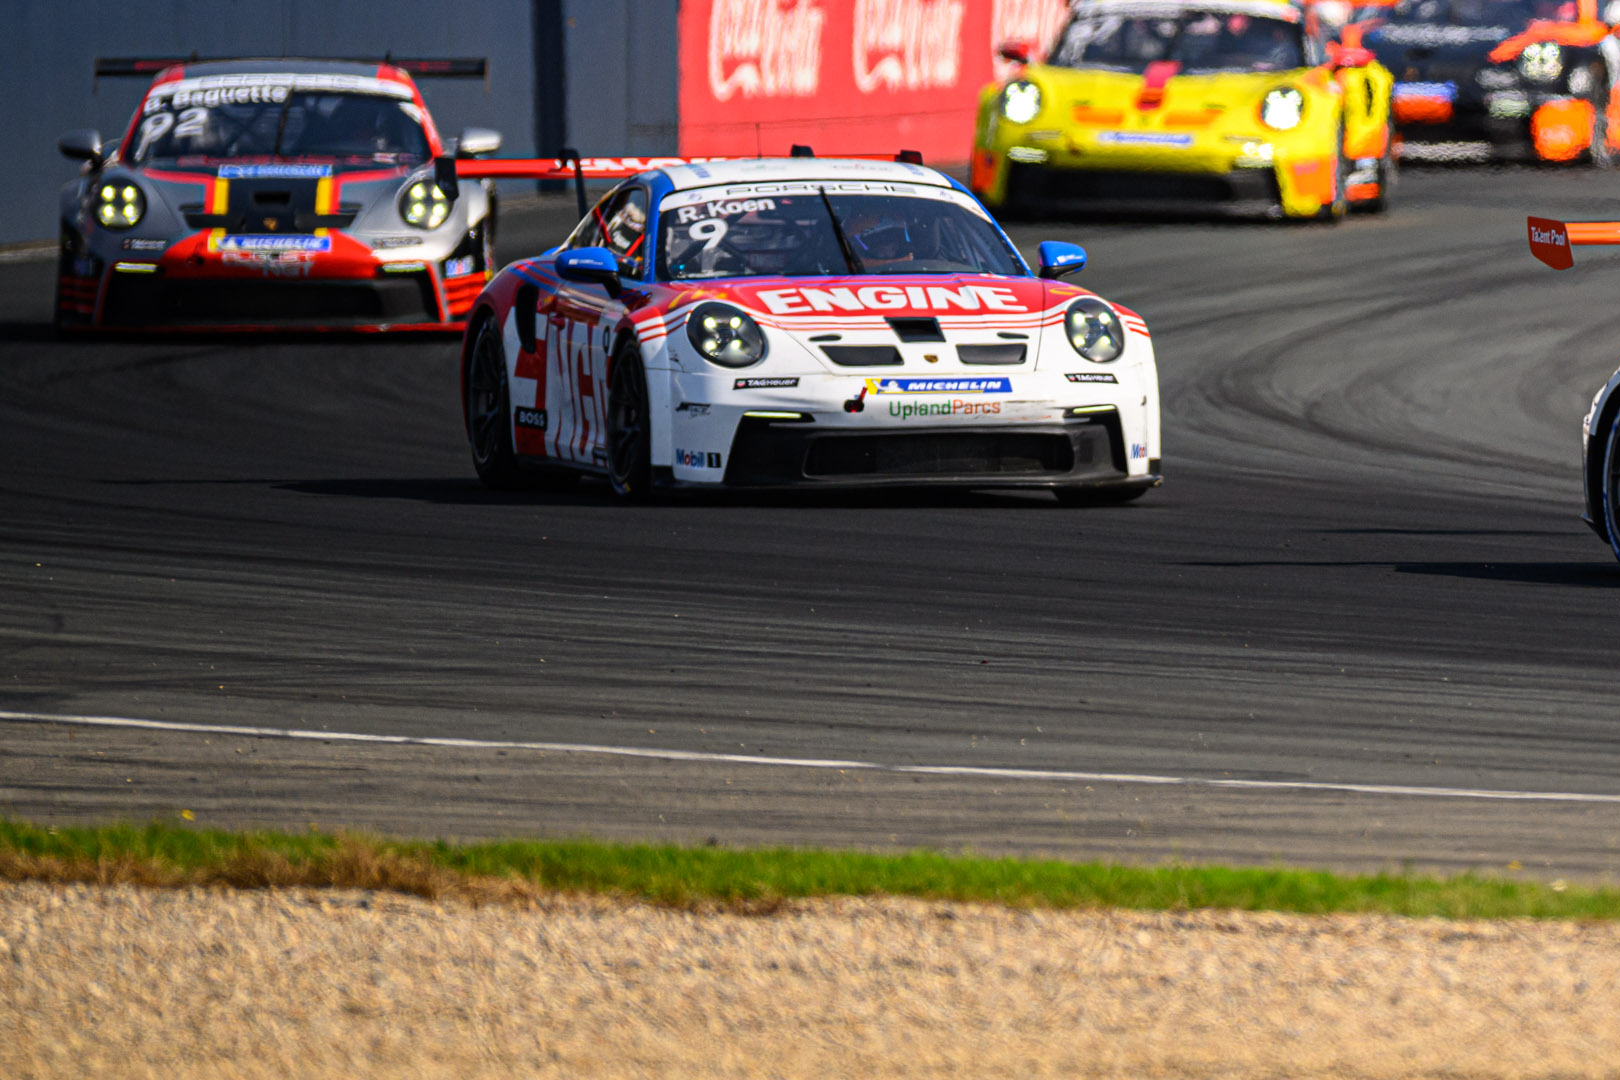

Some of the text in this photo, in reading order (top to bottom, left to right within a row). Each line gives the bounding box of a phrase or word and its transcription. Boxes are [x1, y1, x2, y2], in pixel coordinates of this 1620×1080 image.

[134, 107, 209, 161] 92
[726, 182, 917, 195] PORSCHE
[677, 198, 776, 224] R. Koen
[688, 218, 728, 250] 9
[1530, 226, 1551, 245] Talent
[756, 285, 1028, 315] ENGINE
[907, 380, 1002, 391] MICHELIN
[519, 409, 545, 427] BOSS
[889, 399, 1001, 419] UplandParcs
[676, 448, 704, 468] Mobil
